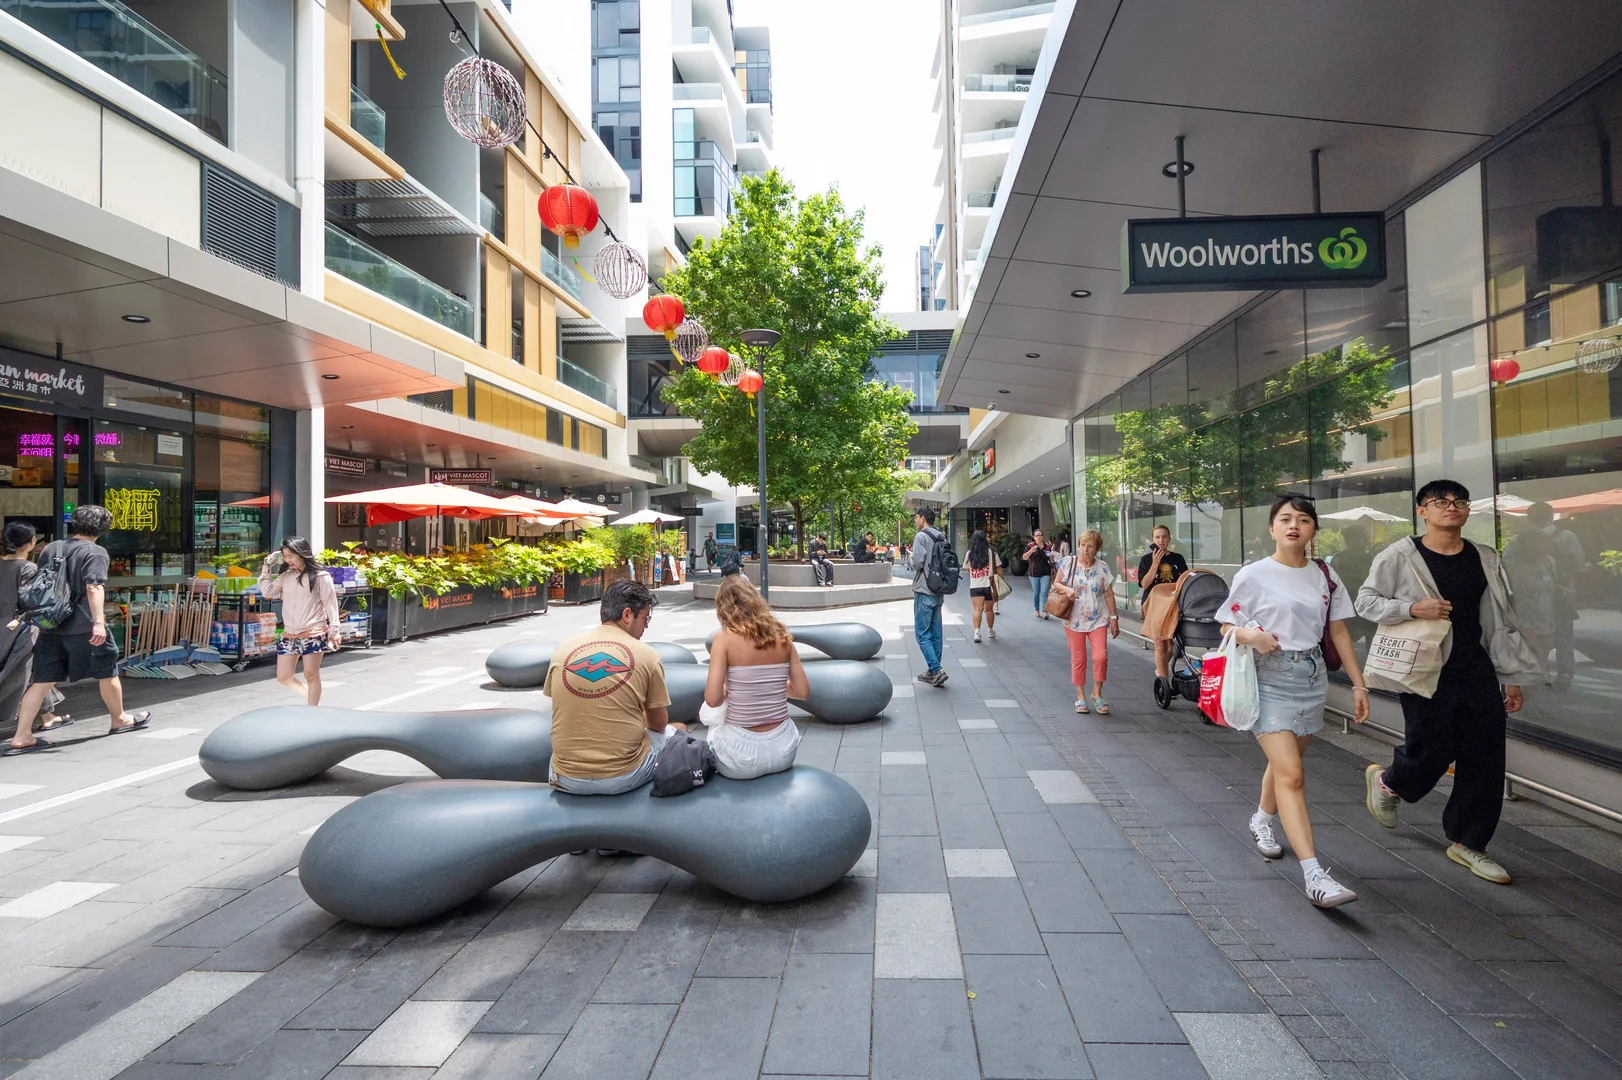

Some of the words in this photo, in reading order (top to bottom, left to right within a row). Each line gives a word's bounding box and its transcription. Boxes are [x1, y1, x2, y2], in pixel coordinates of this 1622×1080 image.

[1140, 236, 1314, 268] Woolworths
[24, 368, 85, 395] market
[1379, 636, 1407, 648] SECRET
[1376, 647, 1401, 658] STASH
